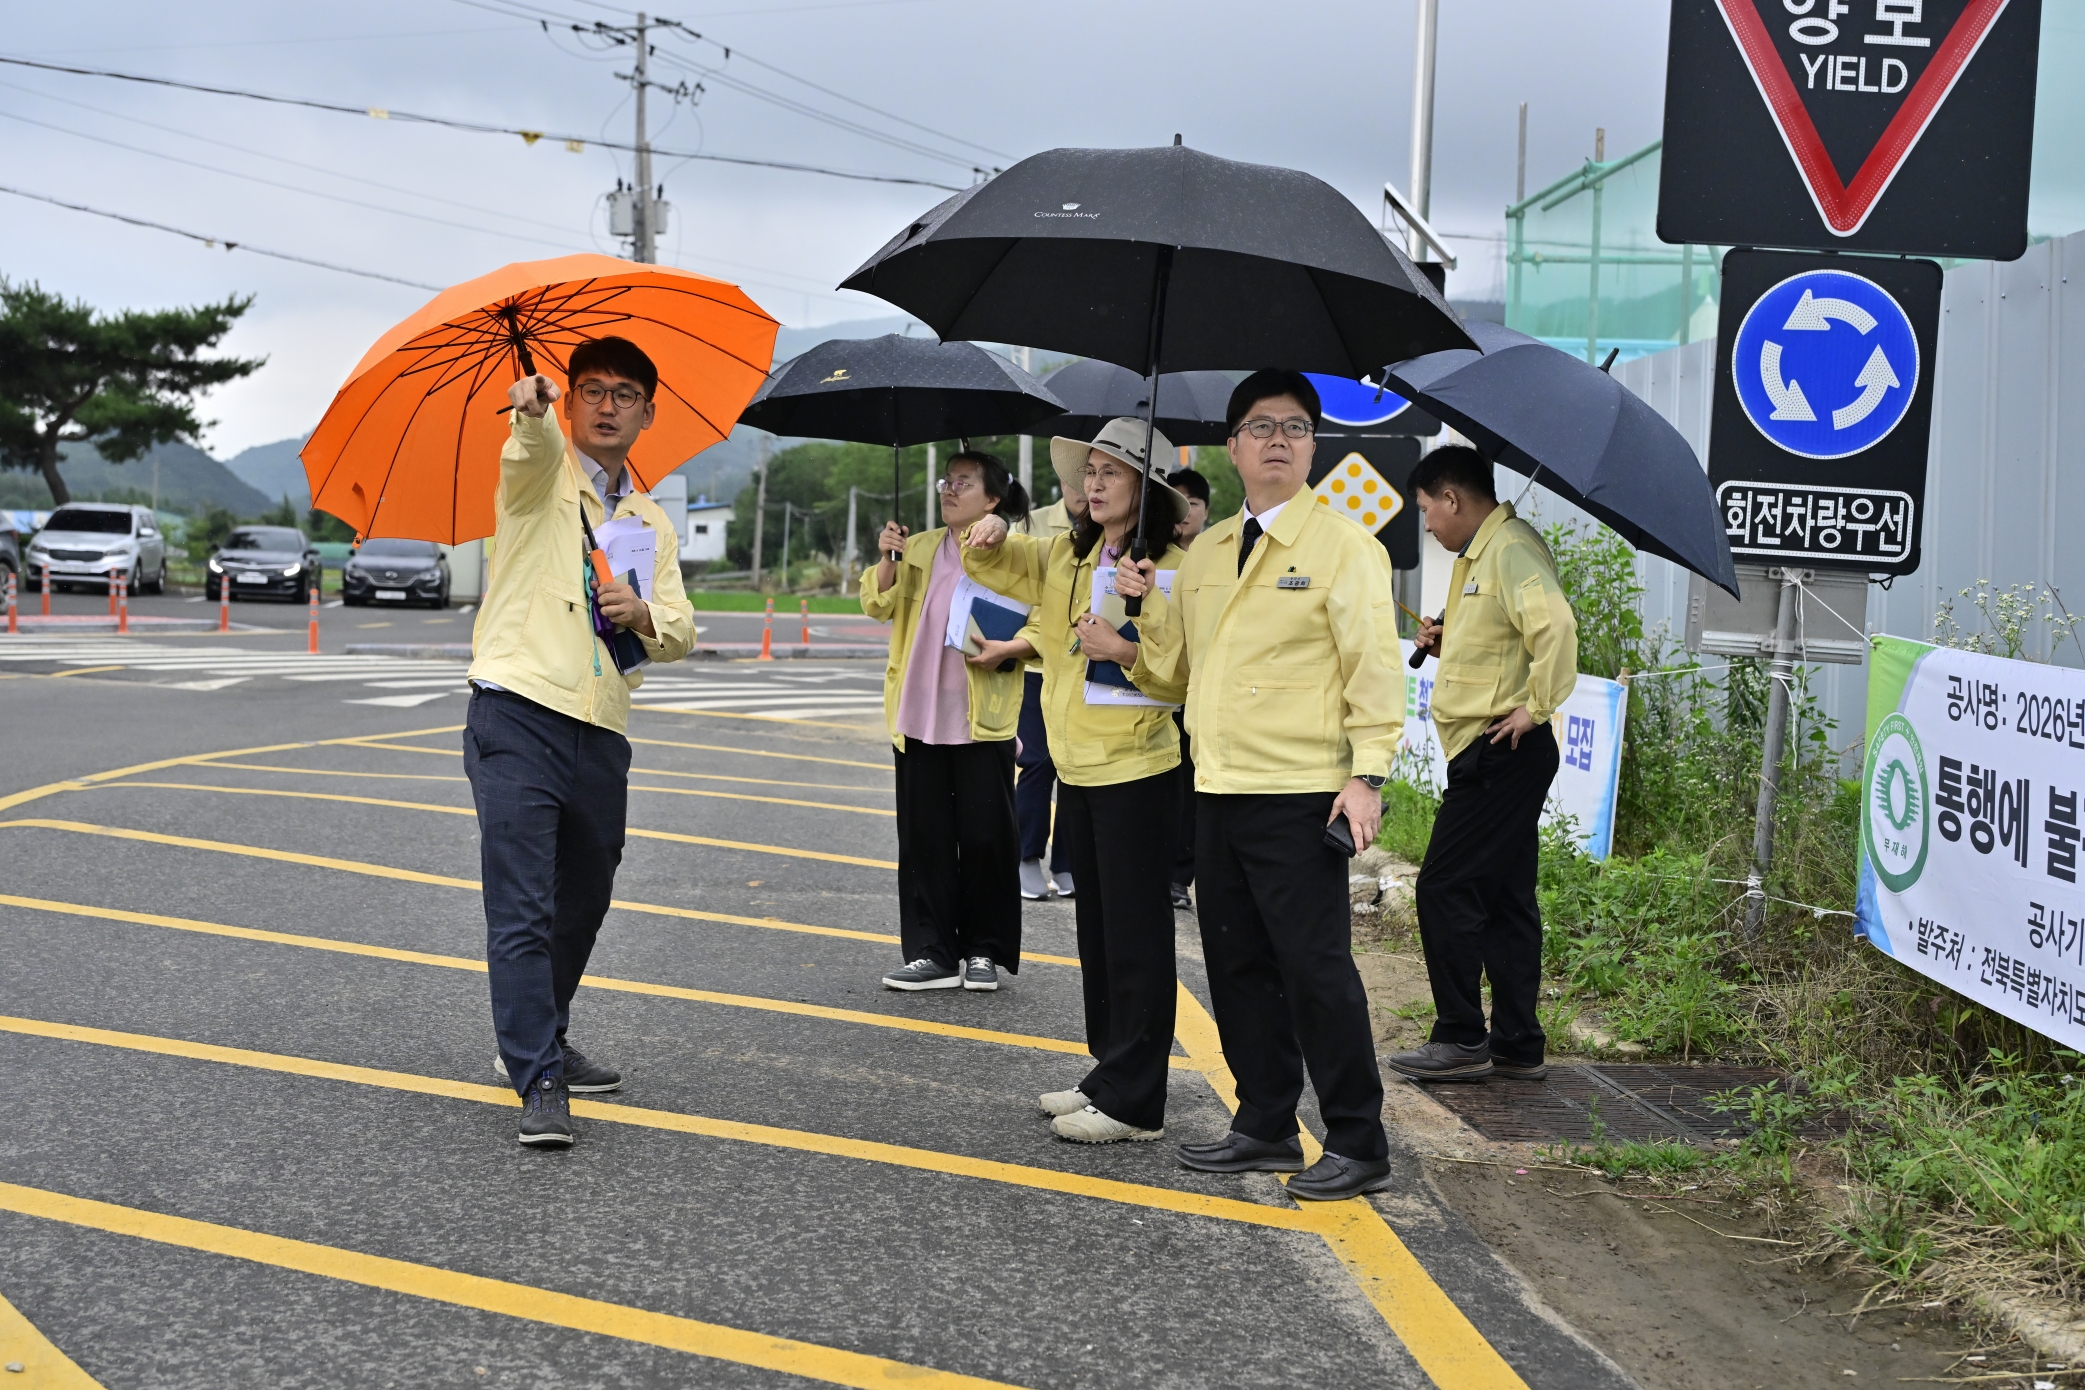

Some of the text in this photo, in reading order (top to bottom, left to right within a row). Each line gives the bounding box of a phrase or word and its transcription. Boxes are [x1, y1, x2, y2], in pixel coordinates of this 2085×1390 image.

[1800, 53, 1908, 94] YIELD
[1725, 490, 1905, 552] 회전차량우선
[1565, 715, 1595, 772] 모집
[1872, 720, 1905, 758] SAFETY FIRST
[2016, 692, 2085, 750] 2026년
[1935, 755, 2085, 884] 통행에 불
[2027, 901, 2085, 966] 공사기
[1917, 917, 1965, 970] 발주처
[1980, 946, 2085, 1027] 전북특별자치도
